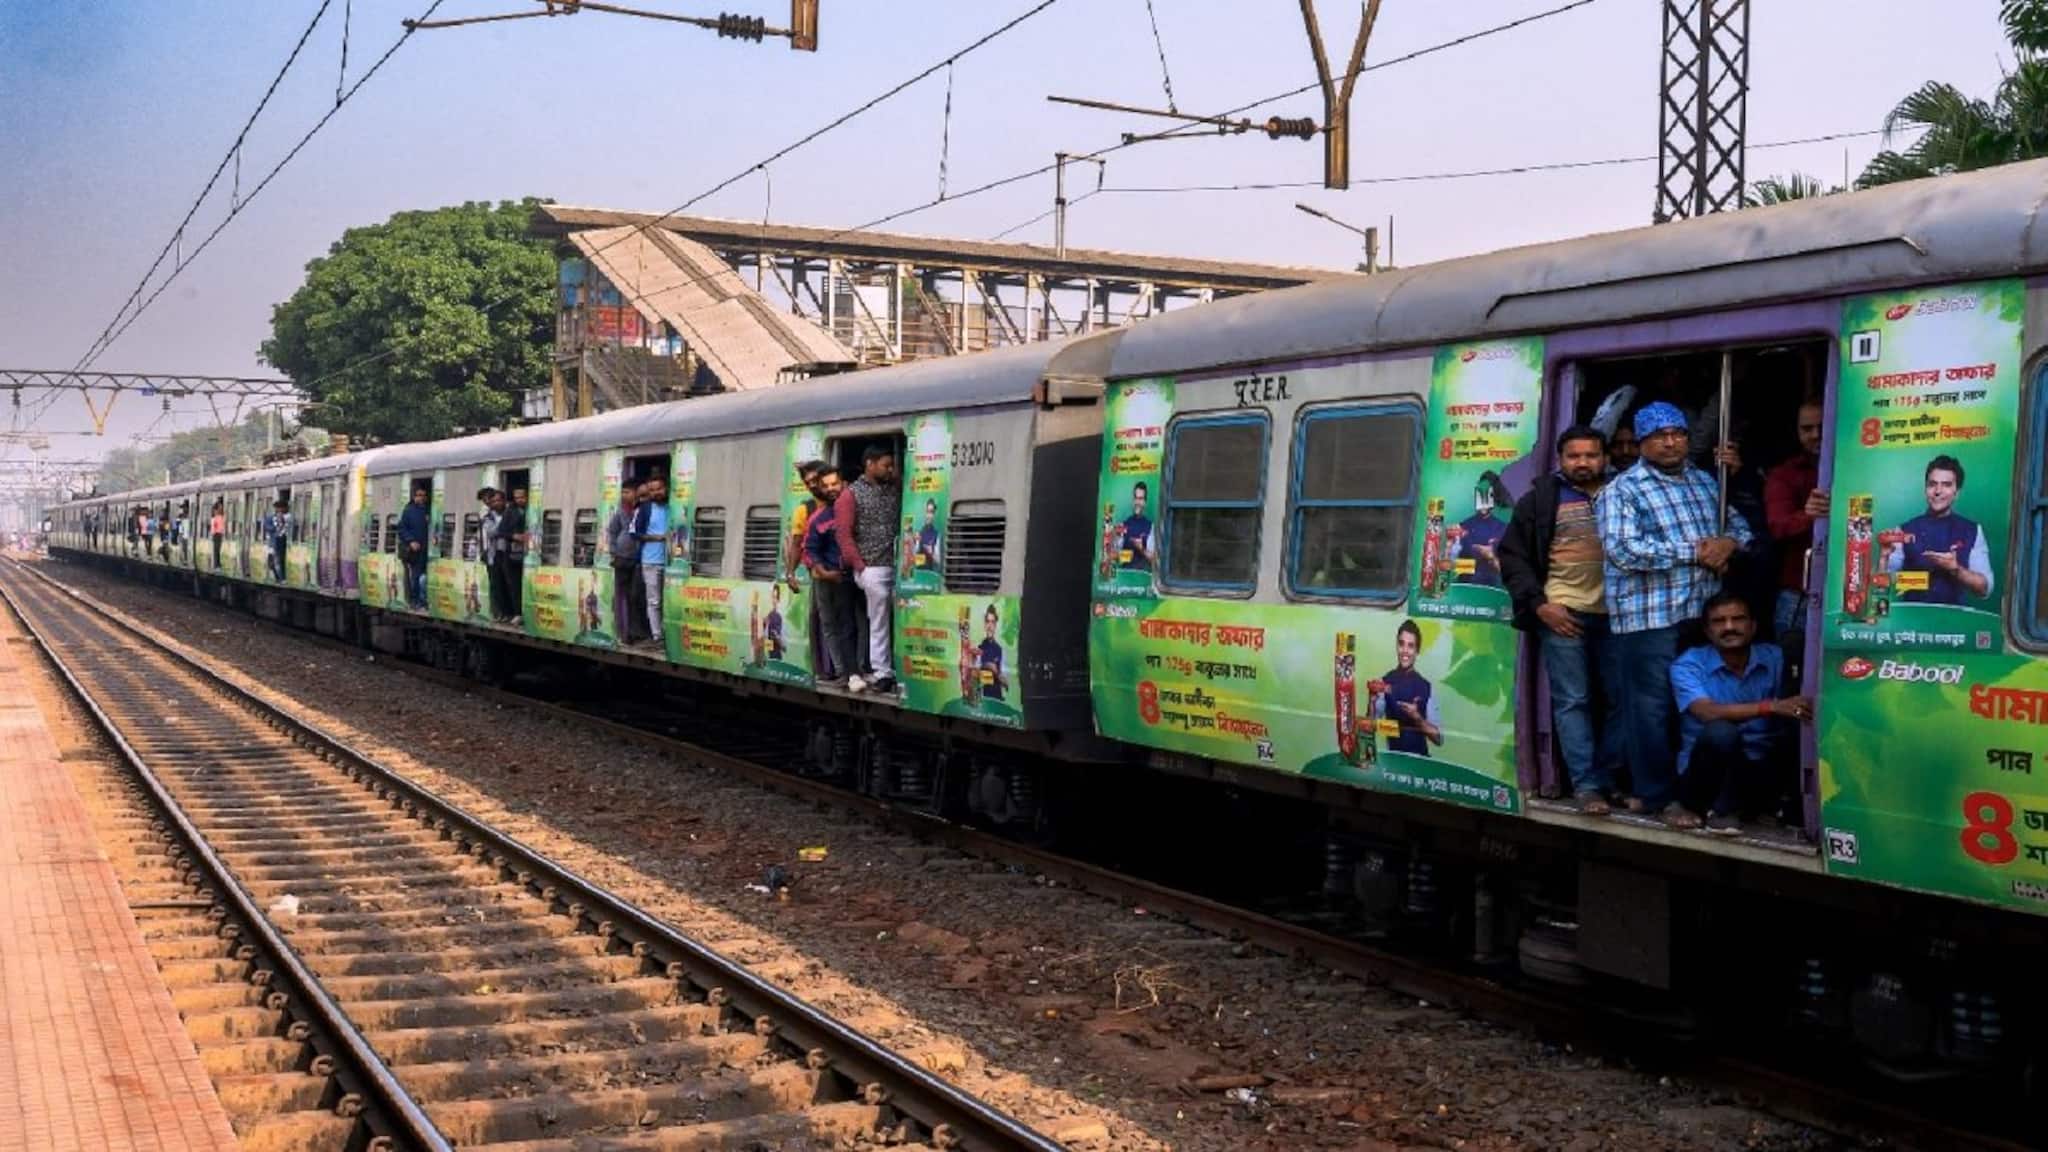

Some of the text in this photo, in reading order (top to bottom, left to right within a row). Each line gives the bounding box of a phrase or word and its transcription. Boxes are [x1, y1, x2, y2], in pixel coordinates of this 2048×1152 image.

[1878, 659, 1964, 684] Babool
[1986, 748, 2033, 774] পান
[1829, 838, 1857, 859] R3
